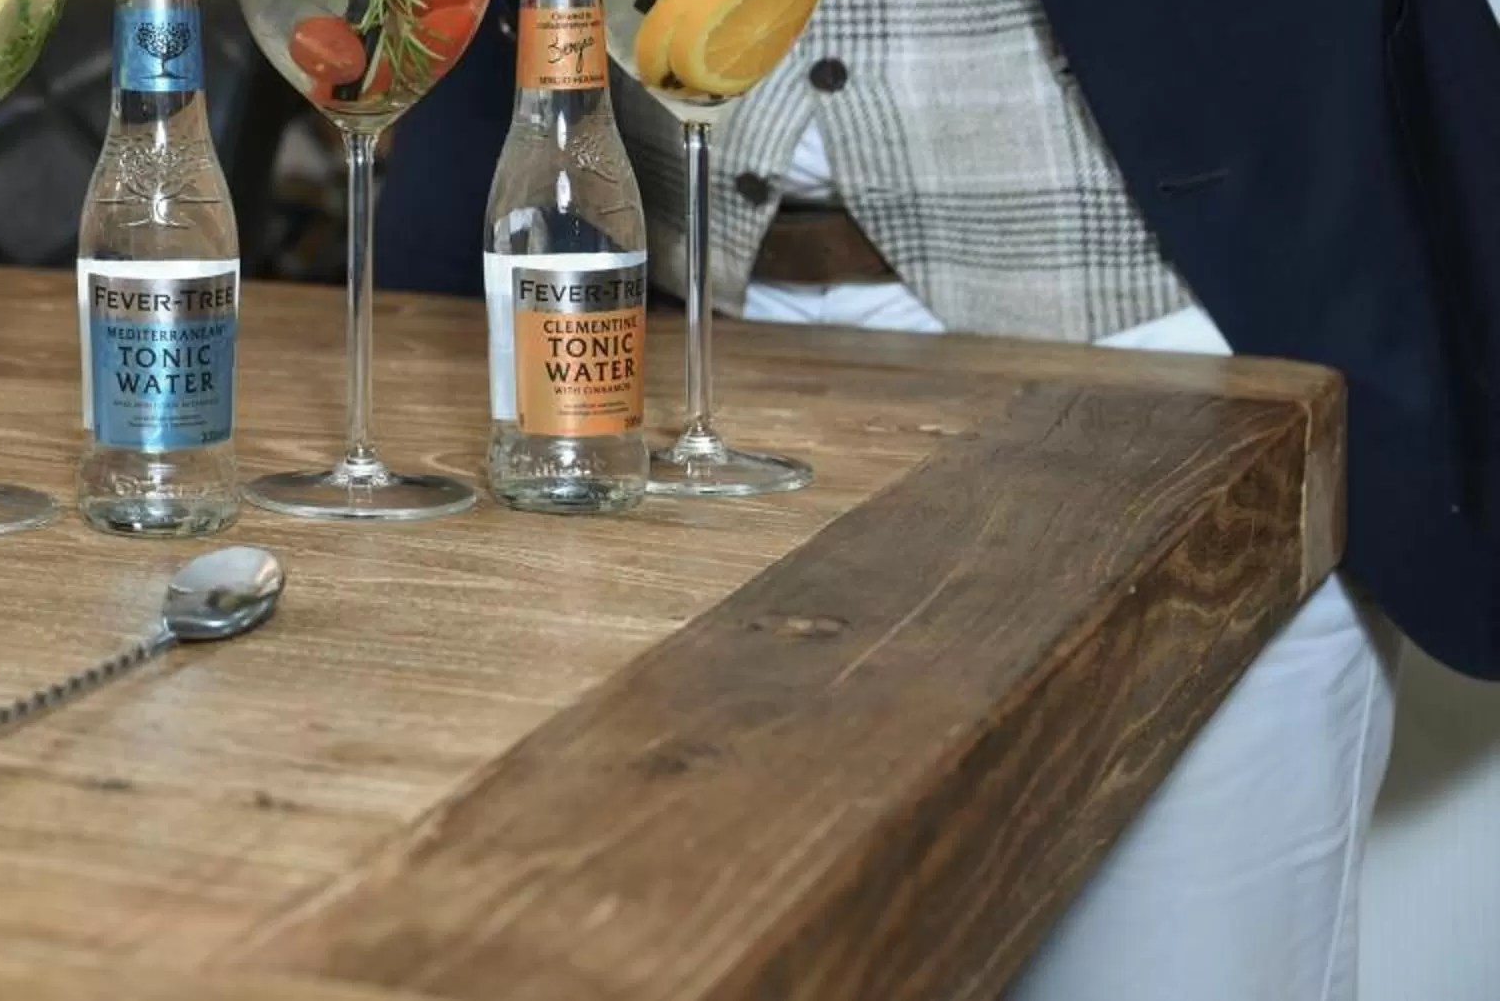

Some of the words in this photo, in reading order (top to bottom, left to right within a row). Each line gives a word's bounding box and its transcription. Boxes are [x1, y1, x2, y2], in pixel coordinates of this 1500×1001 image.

[94, 286, 234, 312] FEVER-TREE
[543, 315, 638, 334] CLEMENTINE
[118, 344, 212, 368] TONIC
[547, 333, 634, 359] TONIC
[545, 358, 635, 383] WATER
[115, 371, 214, 395] WATER
